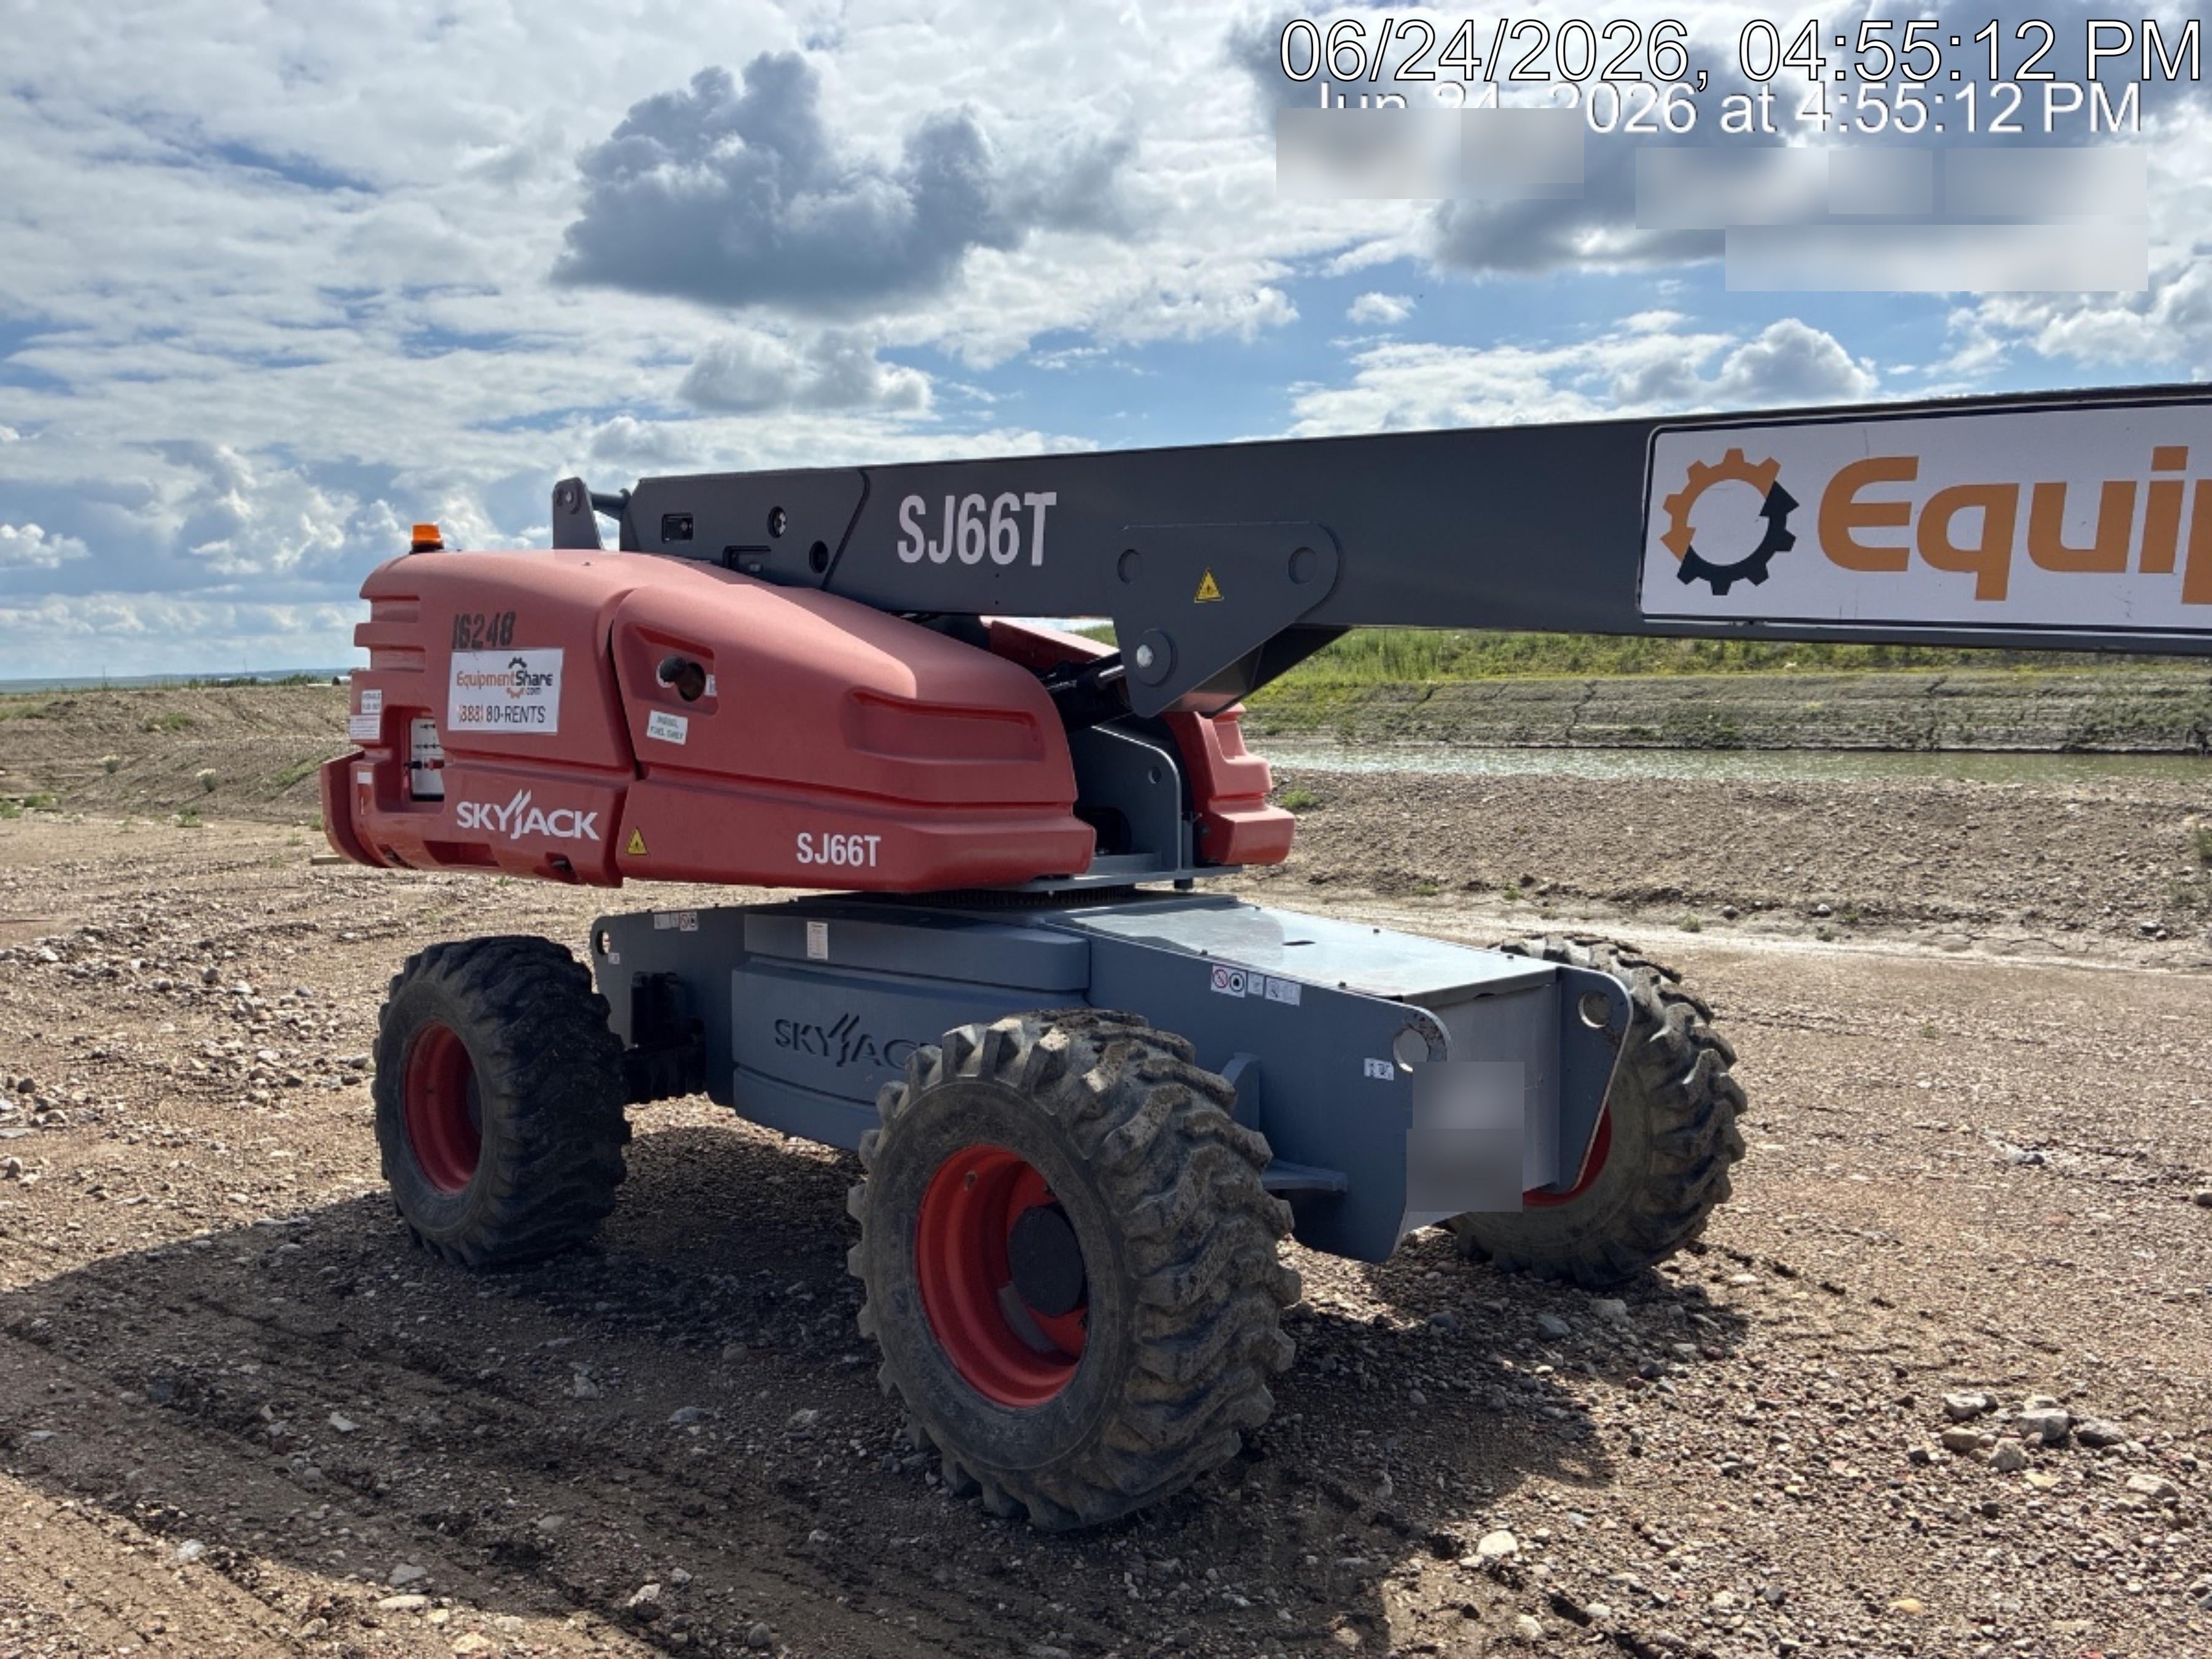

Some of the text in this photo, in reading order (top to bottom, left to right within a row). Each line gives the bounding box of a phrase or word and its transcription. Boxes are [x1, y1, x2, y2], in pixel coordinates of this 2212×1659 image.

[897, 492, 1057, 567] SJ66T
[452, 611, 516, 651] 16248
[457, 670, 554, 689] EquipmentShare
[485, 705, 546, 723] 80-RENTS
[457, 789, 600, 841] SKYJACK
[797, 833, 881, 867] SJ66T
[775, 1013, 942, 1071] SKYJAC
